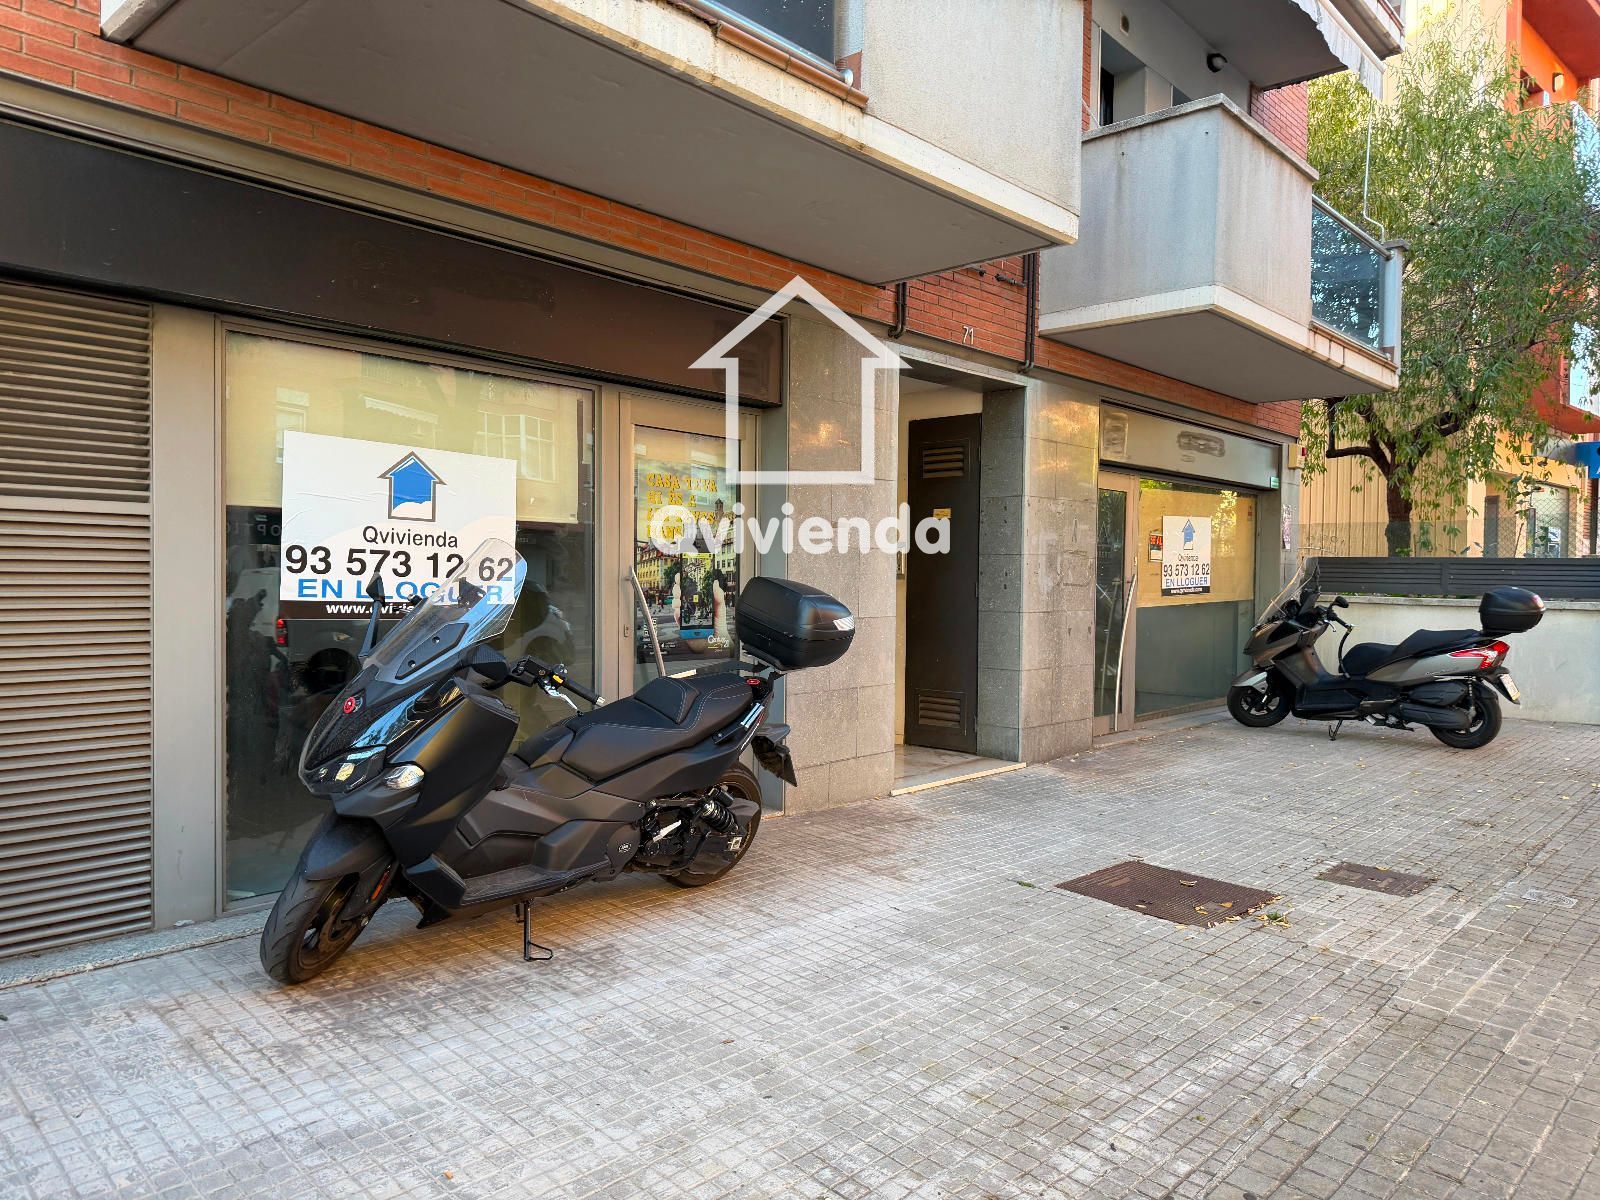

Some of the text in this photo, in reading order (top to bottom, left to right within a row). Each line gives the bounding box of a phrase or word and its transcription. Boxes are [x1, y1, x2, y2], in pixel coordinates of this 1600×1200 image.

[963, 325, 974, 345] 71
[647, 473, 680, 489] CASA
[363, 526, 458, 548] Qvivienda
[286, 545, 513, 581] 93 573 12 62
[1163, 563, 1210, 577] 93 573 12 62
[298, 579, 342, 599] EN
[1165, 576, 1208, 587] EN LLOGUER
